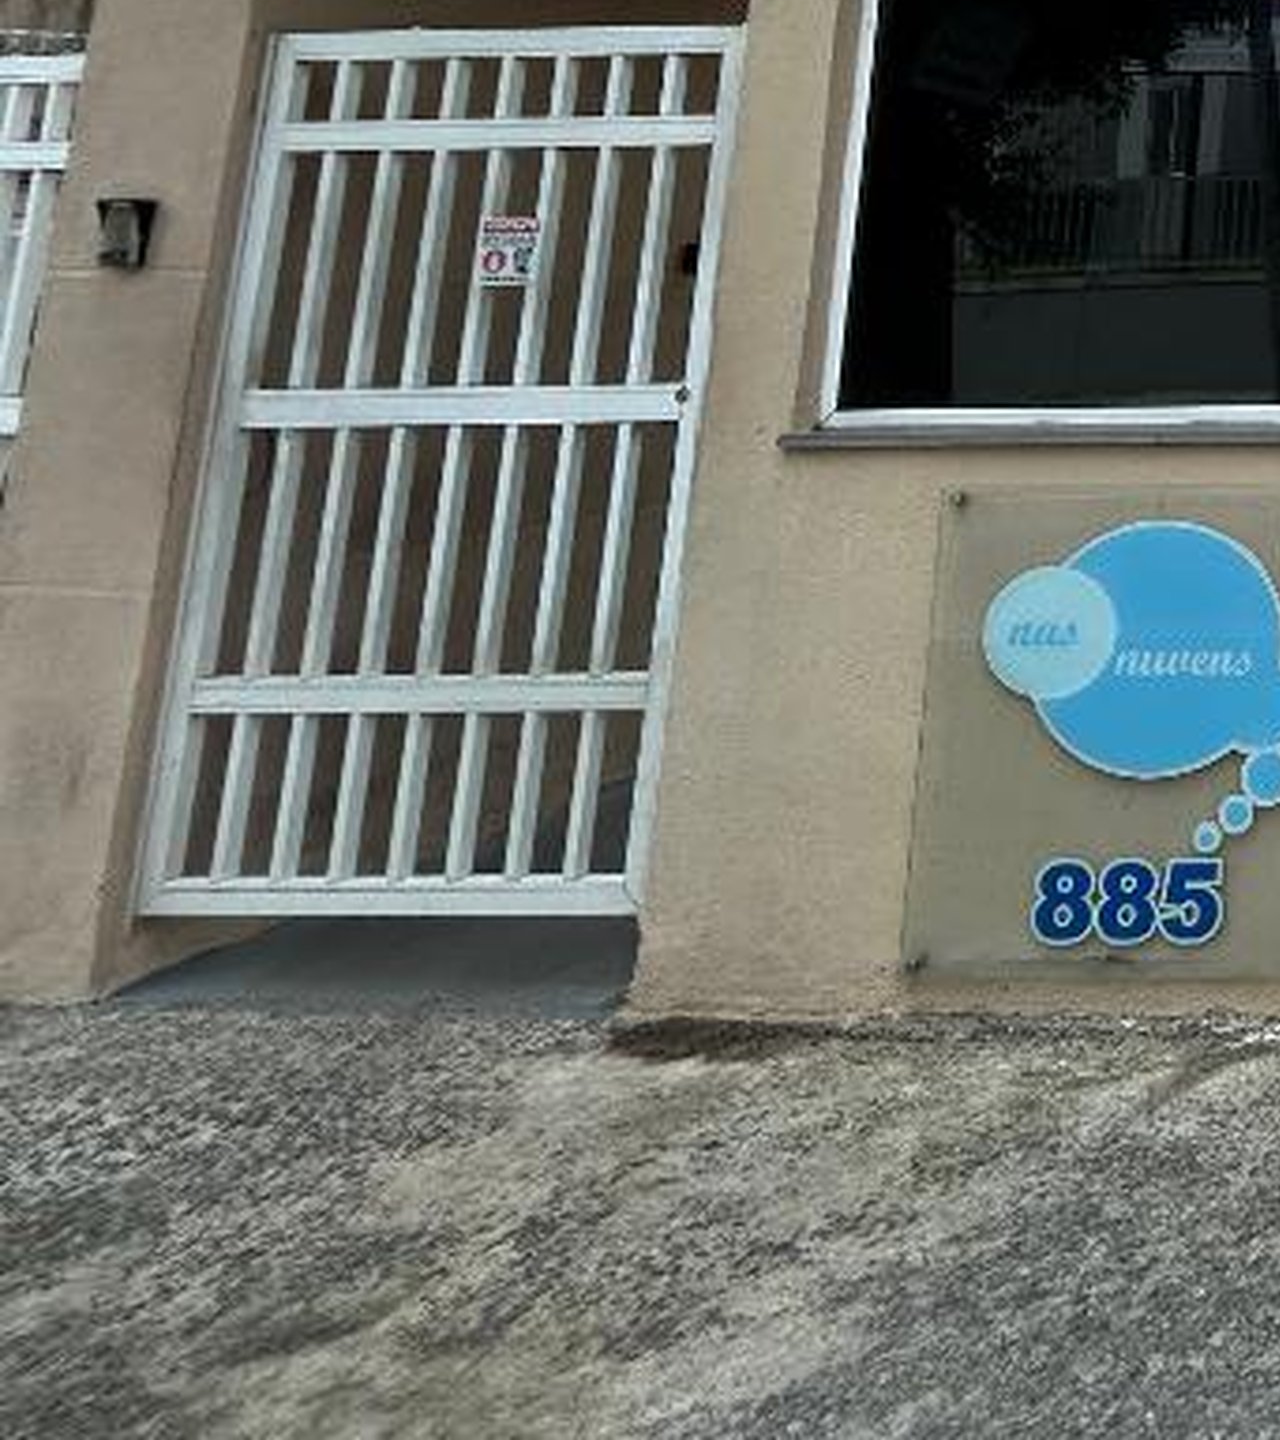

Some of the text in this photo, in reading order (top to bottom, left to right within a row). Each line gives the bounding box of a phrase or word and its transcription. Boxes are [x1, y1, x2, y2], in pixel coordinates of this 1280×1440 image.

[1007, 619, 1079, 648] nas
[1114, 646, 1253, 677] nuvens
[1032, 858, 1224, 946] 885
